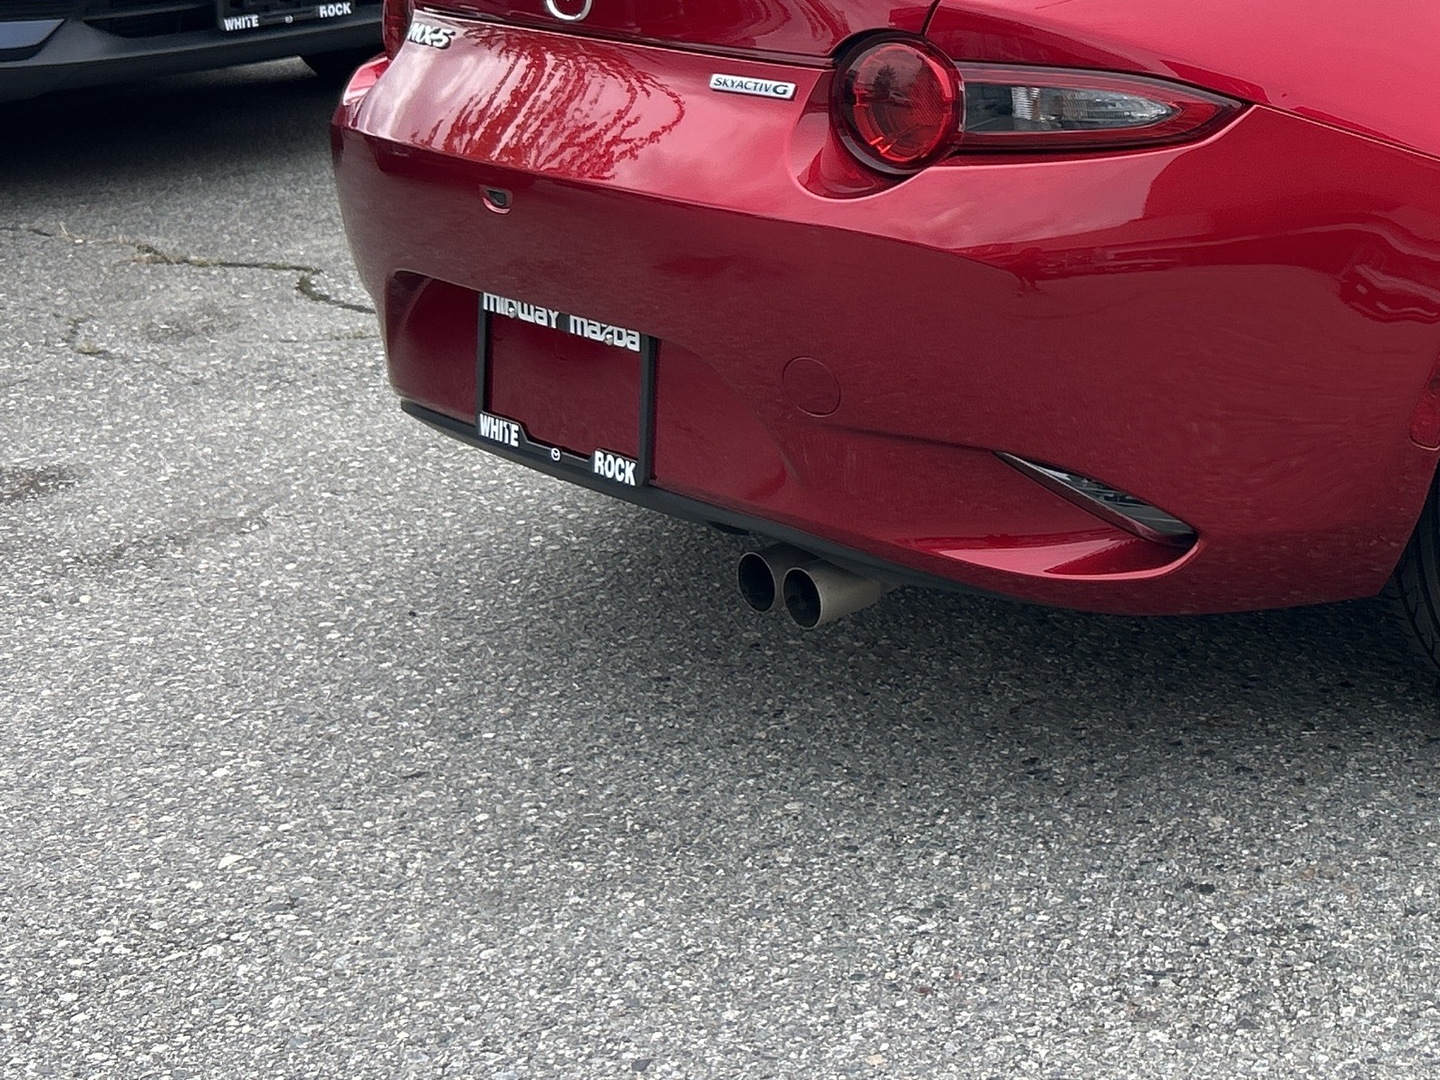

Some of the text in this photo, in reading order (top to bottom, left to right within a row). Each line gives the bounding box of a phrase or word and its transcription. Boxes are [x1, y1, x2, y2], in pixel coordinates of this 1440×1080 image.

[223, 2, 352, 32] WHITE ROCK
[479, 413, 637, 486] WHITE ROCK
